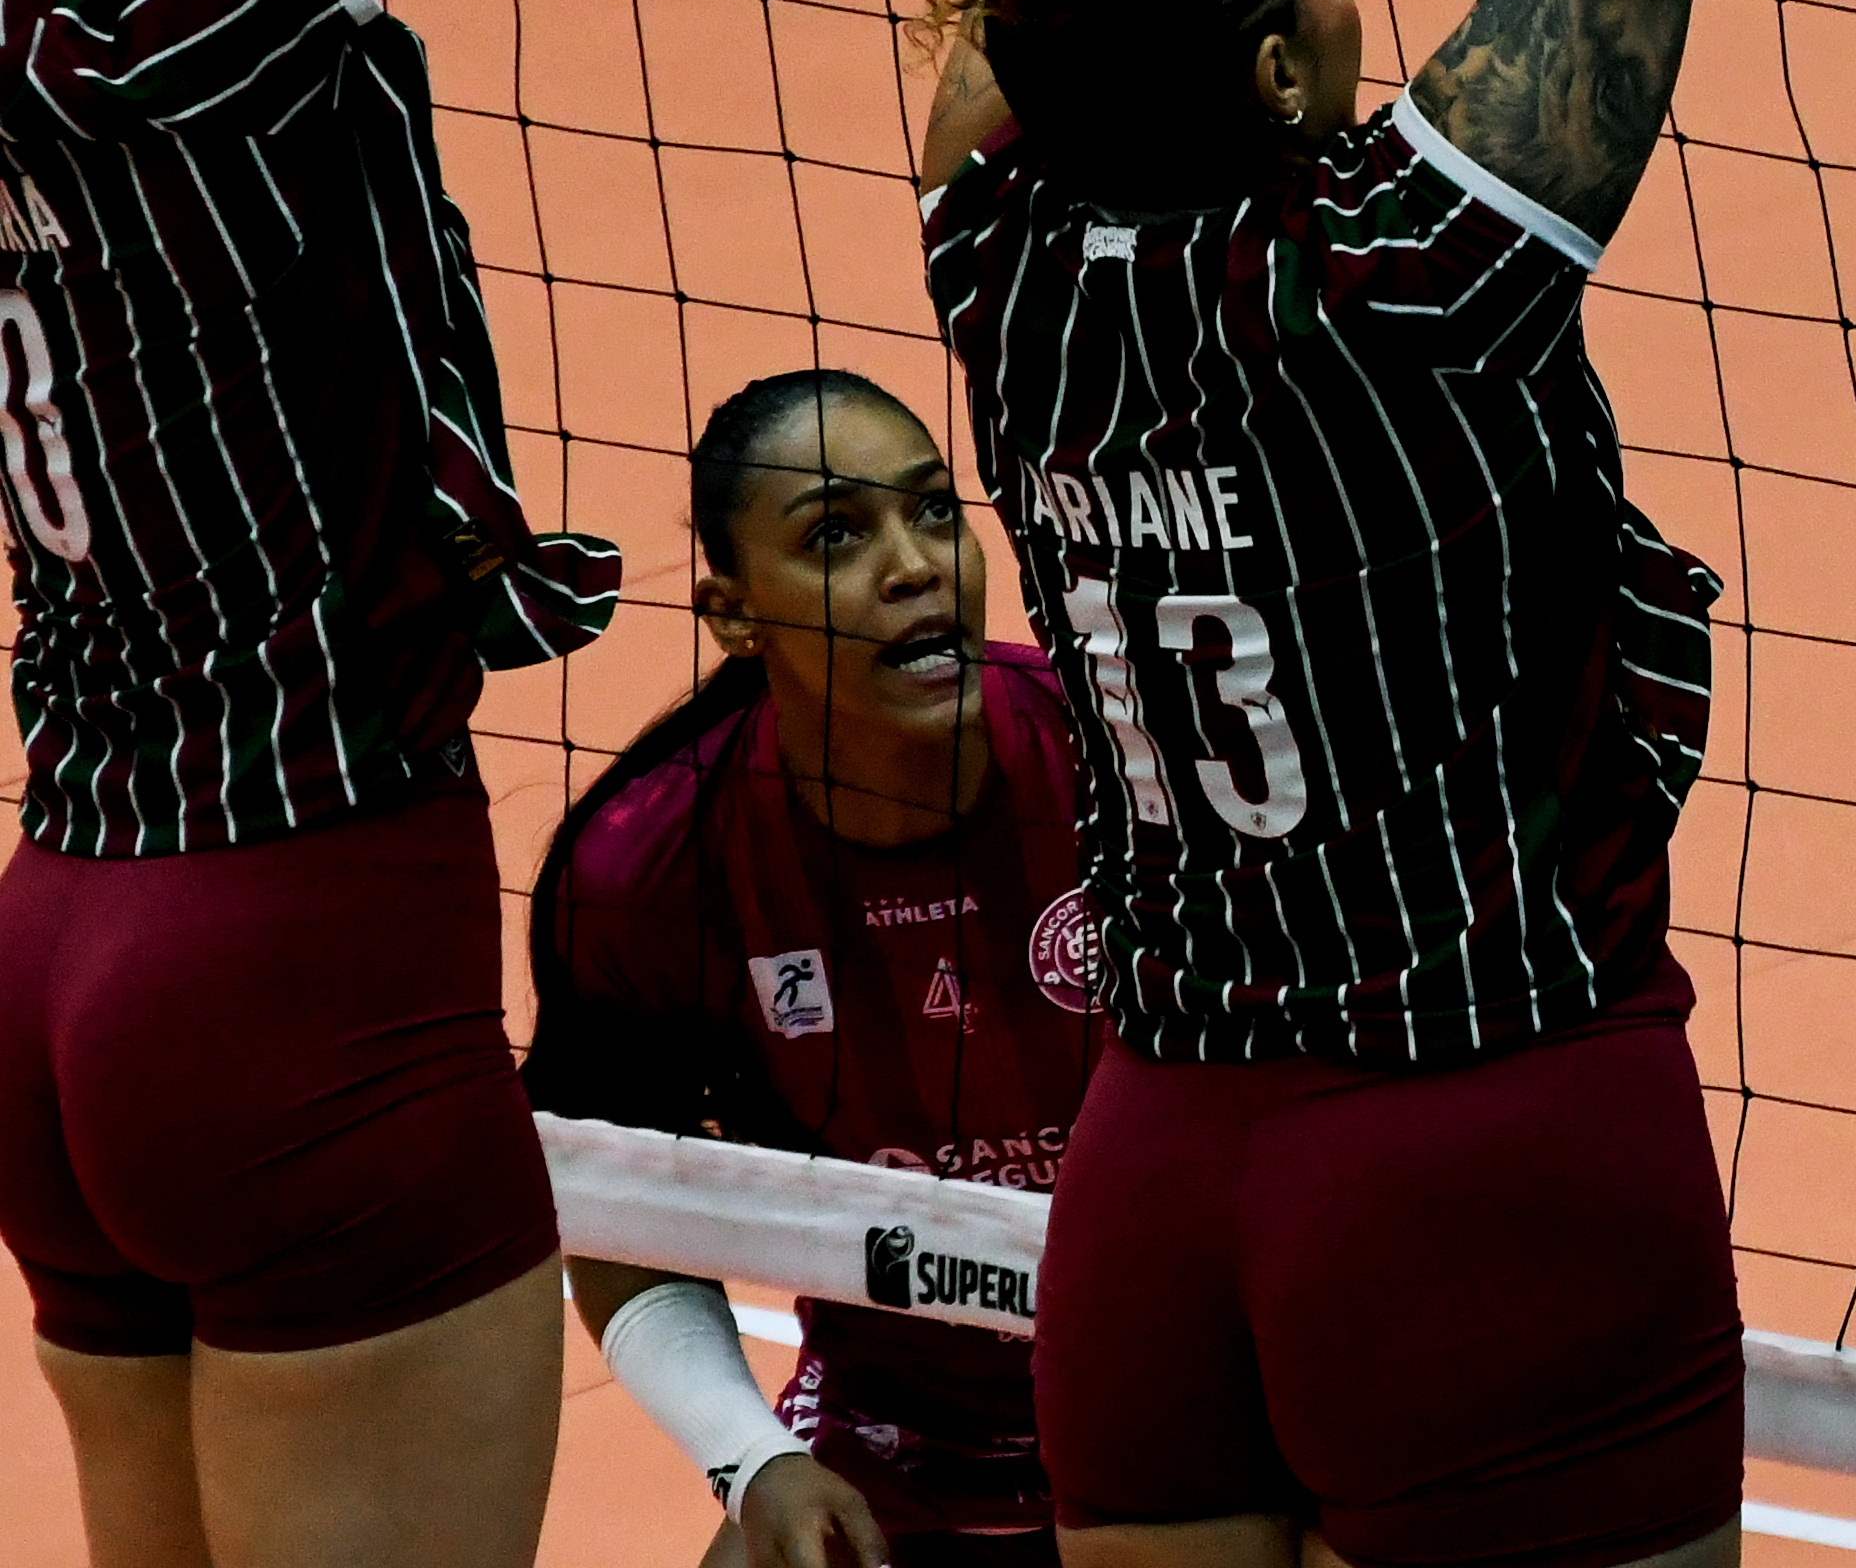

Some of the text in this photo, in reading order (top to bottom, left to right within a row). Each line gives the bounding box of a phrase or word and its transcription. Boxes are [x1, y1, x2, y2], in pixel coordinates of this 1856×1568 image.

[1027, 460, 1254, 552] ARIANE
[1064, 575, 1307, 839] 13
[865, 895, 980, 927] ATHLETA
[936, 1126, 1065, 1173] SANC
[917, 1252, 1037, 1318] SUPERL
